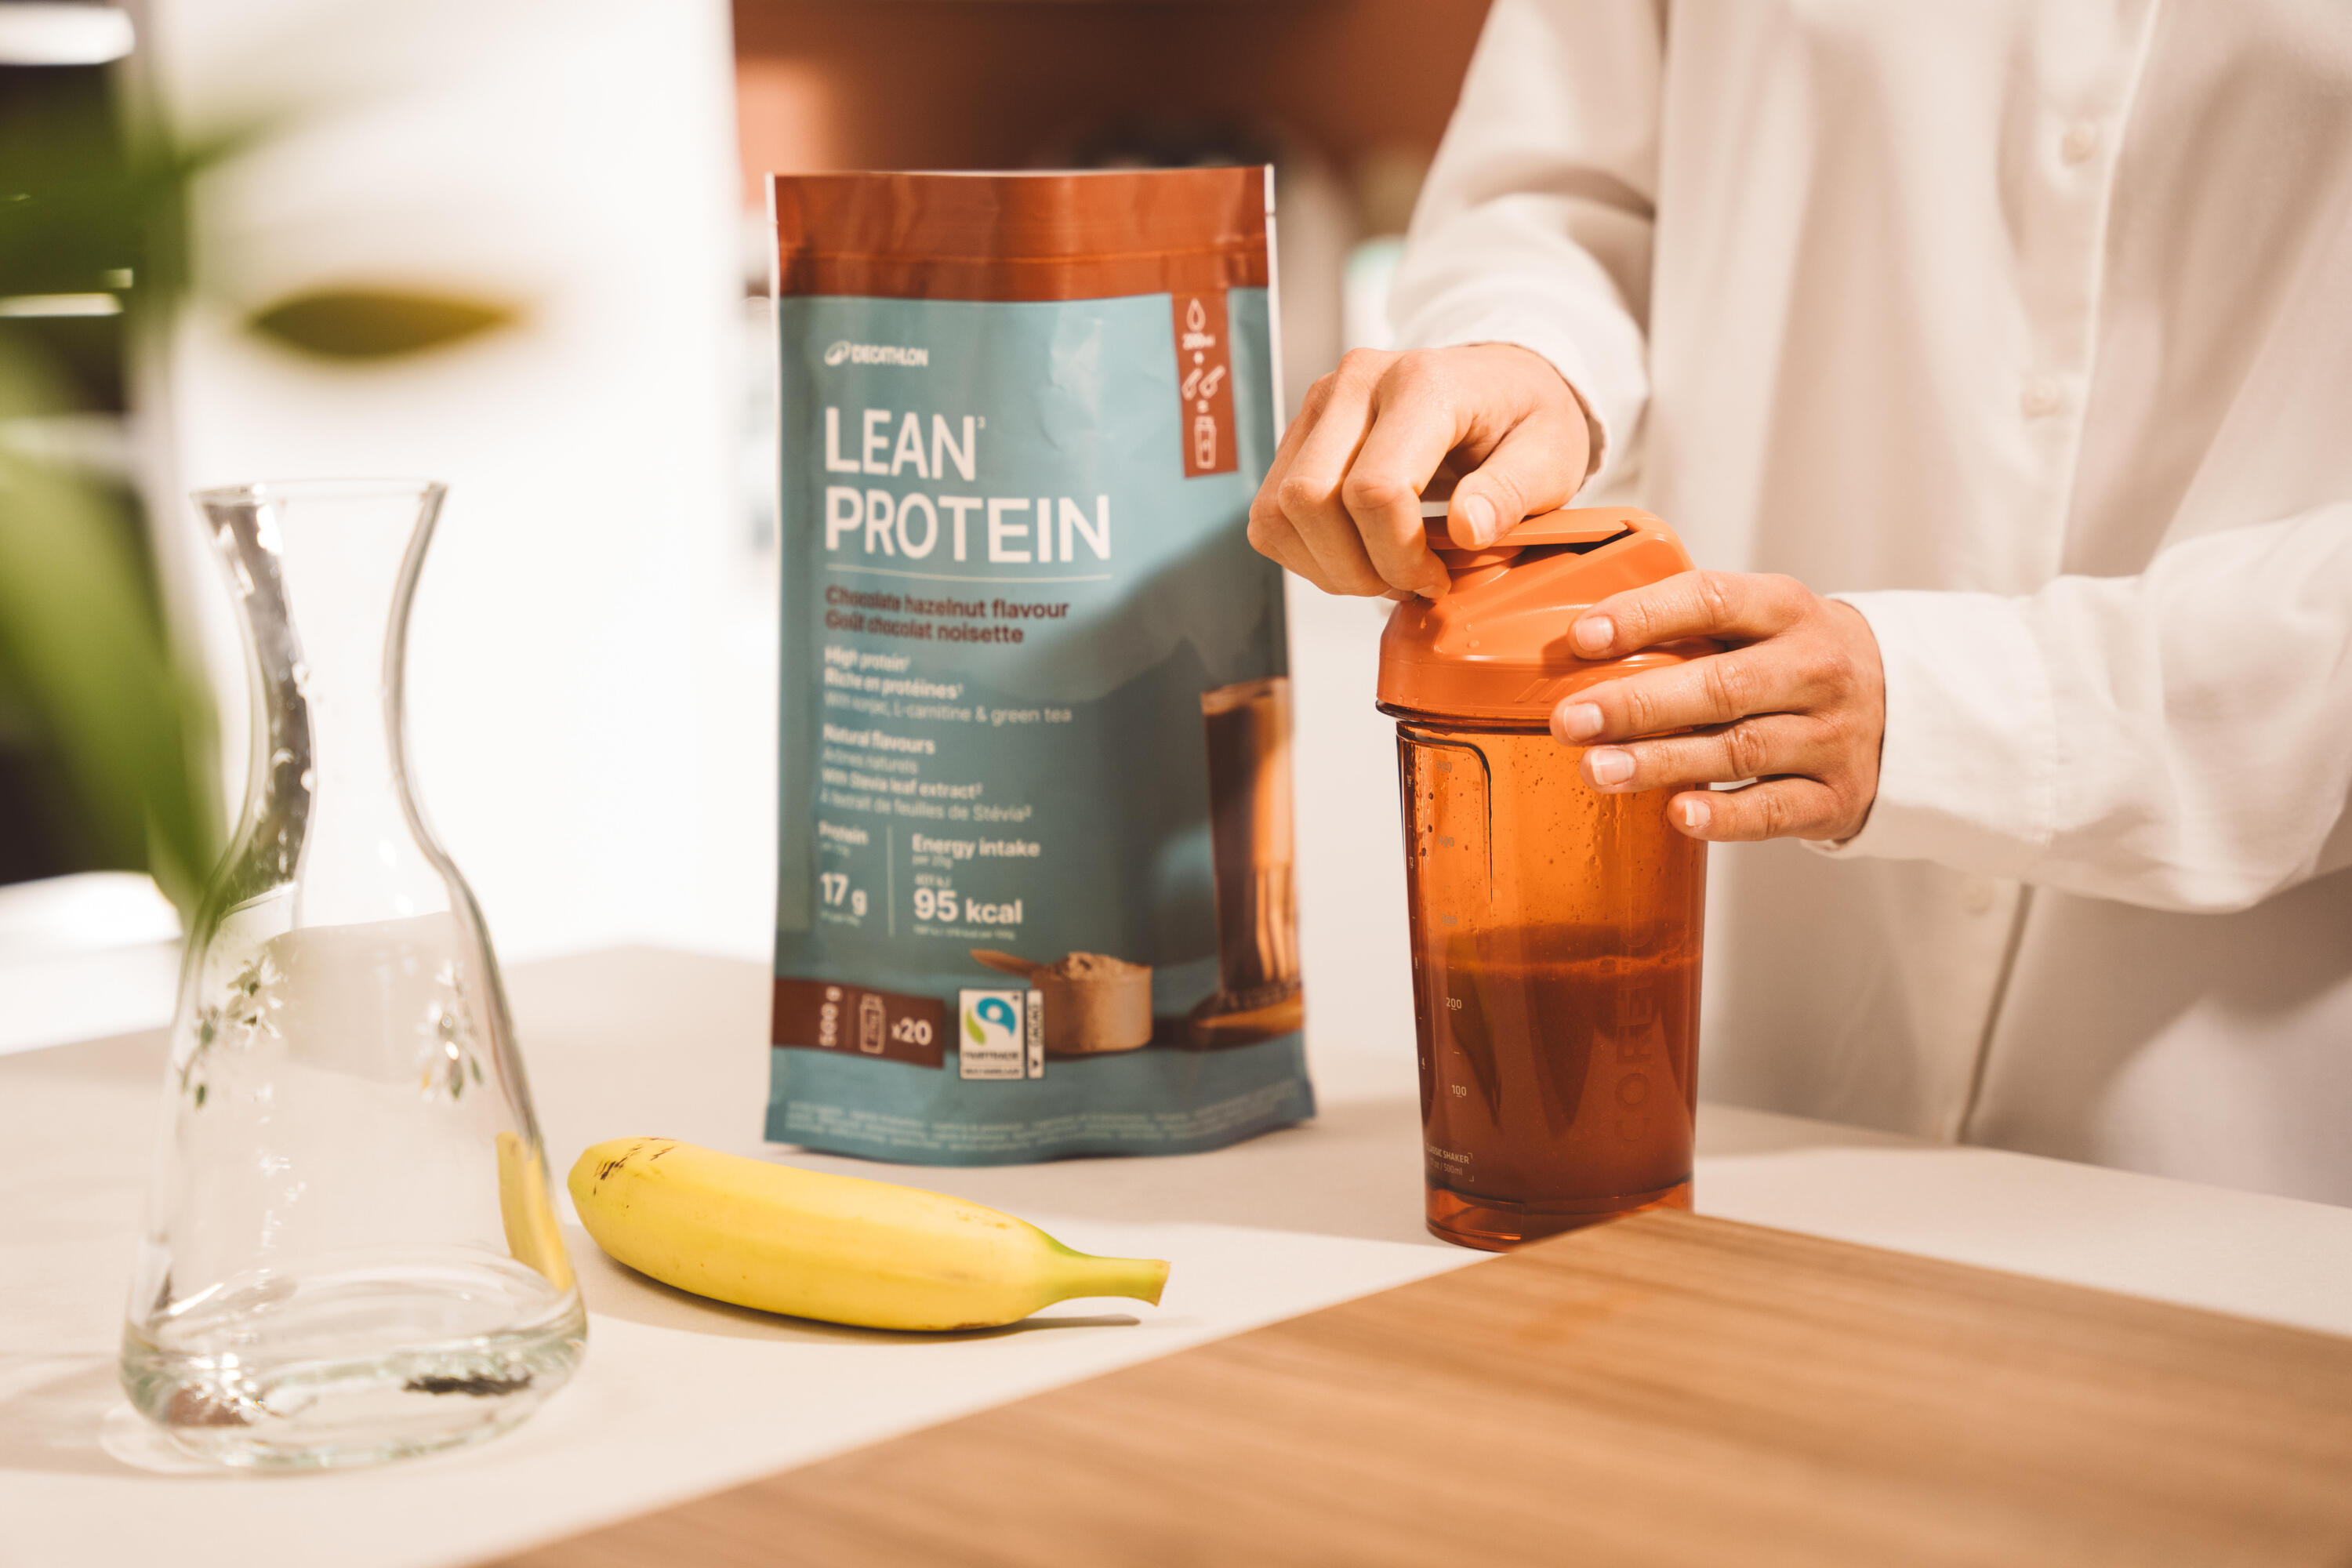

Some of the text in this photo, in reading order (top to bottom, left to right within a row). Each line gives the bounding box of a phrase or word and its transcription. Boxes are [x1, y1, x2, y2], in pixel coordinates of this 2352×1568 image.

[851, 343, 928, 367] DECATHLON
[826, 486, 1111, 563] PROTEIN
[826, 585, 1069, 619] Chocolate hazelnut flavour
[867, 615, 932, 641] chocolat
[937, 622, 1025, 644] noisette
[975, 706, 988, 722] &
[991, 708, 1040, 728] green
[1044, 707, 1073, 723] tea
[947, 804, 969, 821] de
[912, 833, 1041, 860] Energy intake
[1438, 836, 1455, 848] 400
[821, 873, 867, 916] 17 g
[913, 887, 1023, 924] 95 kcal
[1446, 996, 1462, 1009] 200
[891, 1017, 933, 1047] x20
[1451, 1084, 1467, 1097] 100
[1443, 1150, 1469, 1164] SHAKER
[1443, 1163, 1463, 1176] 500ml
